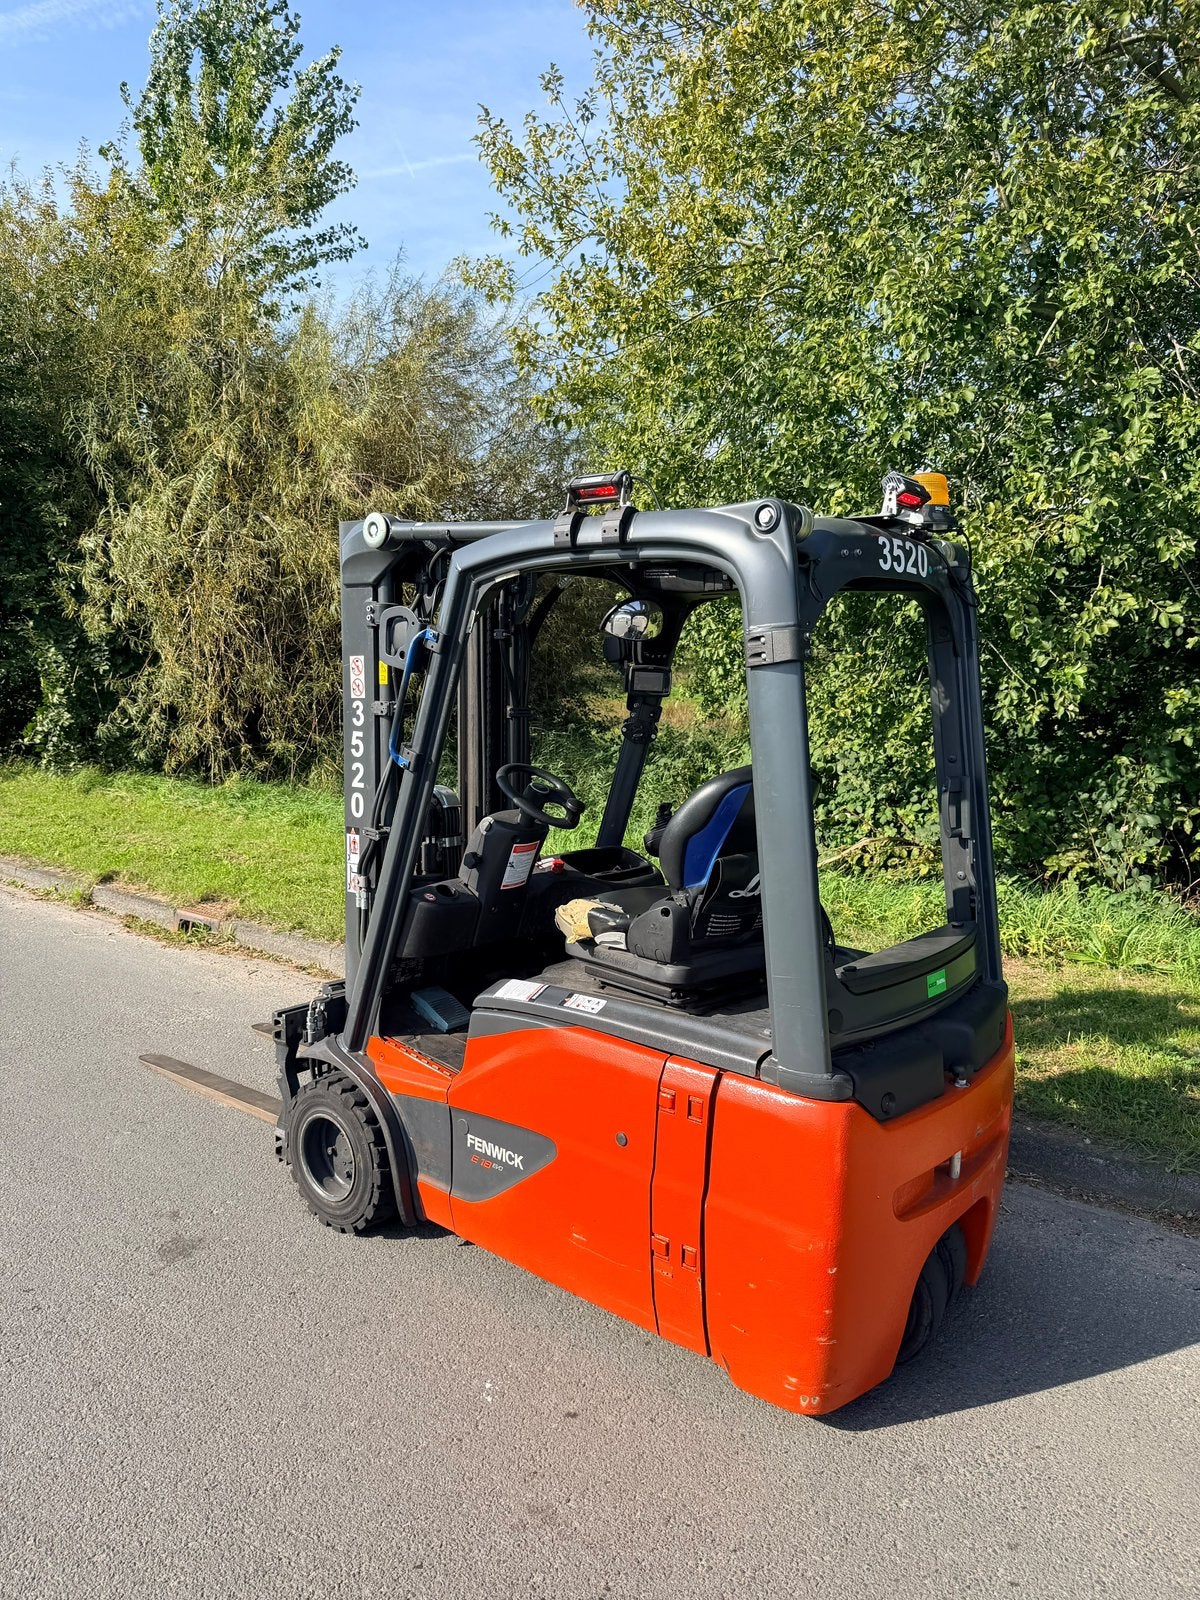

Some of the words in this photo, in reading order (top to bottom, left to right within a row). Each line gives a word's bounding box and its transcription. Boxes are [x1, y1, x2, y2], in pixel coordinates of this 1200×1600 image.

[878, 537, 928, 578] 3520
[351, 700, 365, 819] 3520
[467, 1134, 524, 1170] FENWICK
[471, 1155, 480, 1163] E
